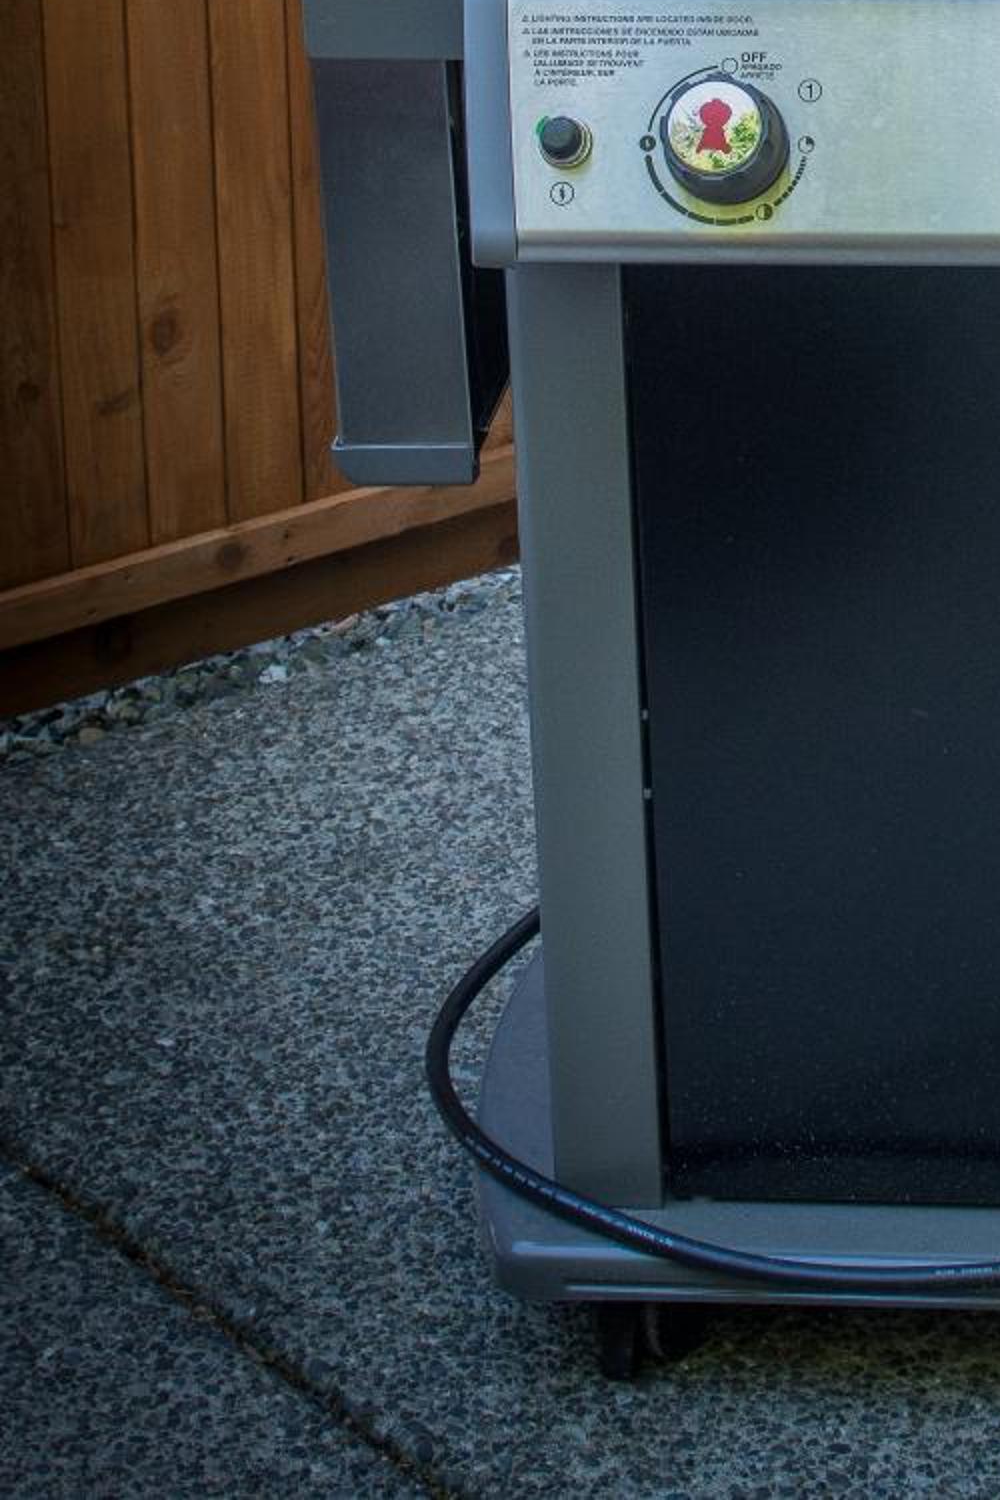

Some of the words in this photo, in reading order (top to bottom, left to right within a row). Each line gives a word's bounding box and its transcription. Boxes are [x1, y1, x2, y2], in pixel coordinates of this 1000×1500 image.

[574, 14, 635, 23] INSTRUCTIONS
[655, 14, 695, 23] LOCATED
[741, 51, 768, 63] OFF
